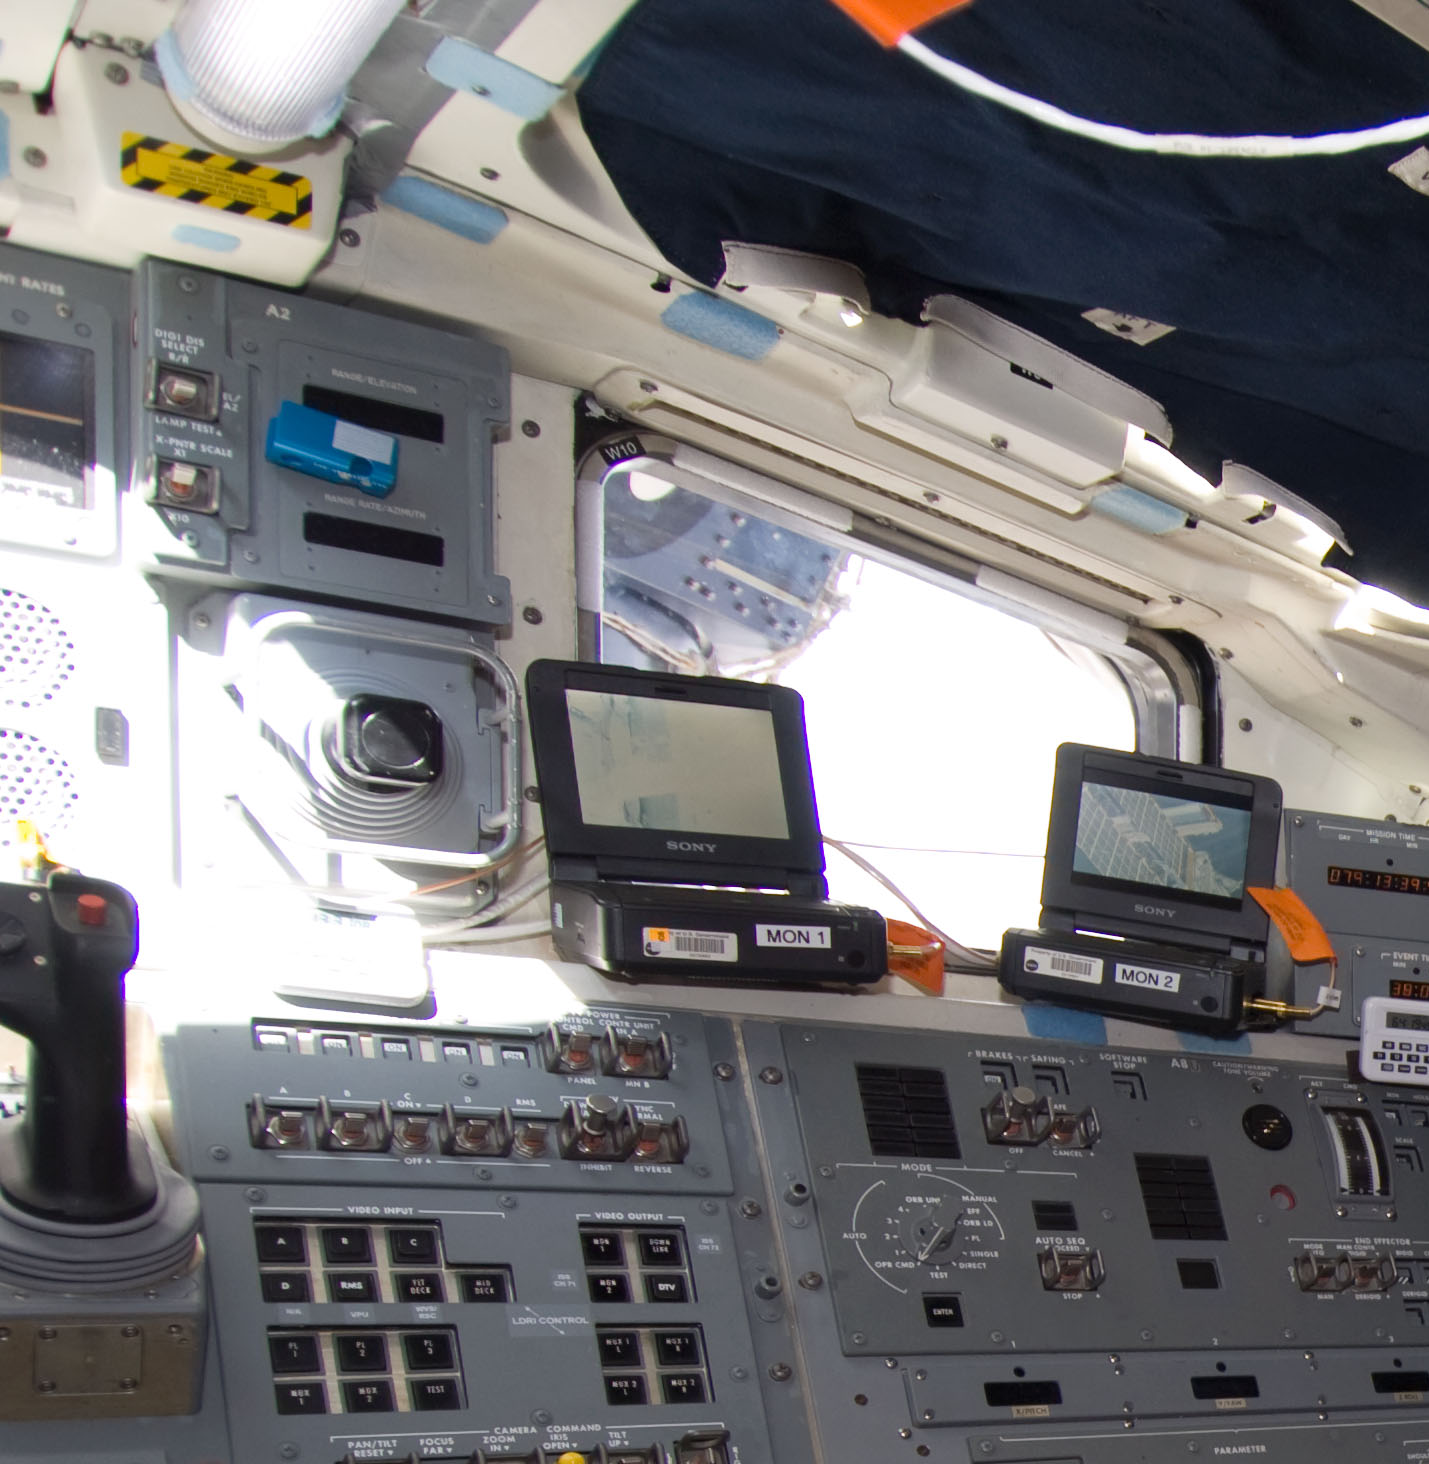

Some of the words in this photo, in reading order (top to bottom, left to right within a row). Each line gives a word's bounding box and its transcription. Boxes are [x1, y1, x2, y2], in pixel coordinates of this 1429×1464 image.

[21, 273, 65, 297] RATES
[265, 303, 291, 321] A2
[155, 416, 187, 431] LAMP
[200, 444, 234, 459] SCALE
[605, 440, 639, 466] W10
[1366, 830, 1396, 840] MISSION
[1398, 832, 1416, 842] TIME
[666, 840, 717, 853] SONY
[1134, 903, 1177, 918] SONY
[767, 929, 810, 945] MON
[1393, 952, 1419, 963] EVENT
[1121, 968, 1159, 986] MON
[1163, 975, 1174, 989] 2
[974, 1050, 1013, 1061] BRAKES
[1031, 1054, 1066, 1065] SAFING
[1099, 1053, 1148, 1064] SOFTWARE
[1113, 1060, 1136, 1070] STOP
[568, 1077, 598, 1087] PANEL
[1052, 1149, 1083, 1159] CANCEL
[634, 1164, 673, 1175] REVERSE
[901, 1162, 932, 1173] MODE
[347, 1205, 381, 1215] VIDEO
[383, 1206, 414, 1217] INPUT
[595, 1211, 625, 1222] VIDEO
[627, 1212, 665, 1223] OUTPUT
[842, 1231, 868, 1241] AUTO
[1035, 1237, 1062, 1246] AUTO
[340, 1280, 363, 1291] RMS
[657, 1283, 676, 1292] DTV
[538, 1315, 590, 1326] CONTROL
[494, 1425, 538, 1436] CAMERA
[546, 1423, 602, 1434] COMMAND
[348, 1439, 398, 1451] PAN/TILT
[420, 1438, 455, 1448] FOCUS
[483, 1434, 517, 1446] ZOOM
[354, 1448, 385, 1459] RESET
[543, 1441, 570, 1451] OPEN
[1213, 1445, 1267, 1456] PARAMETER
